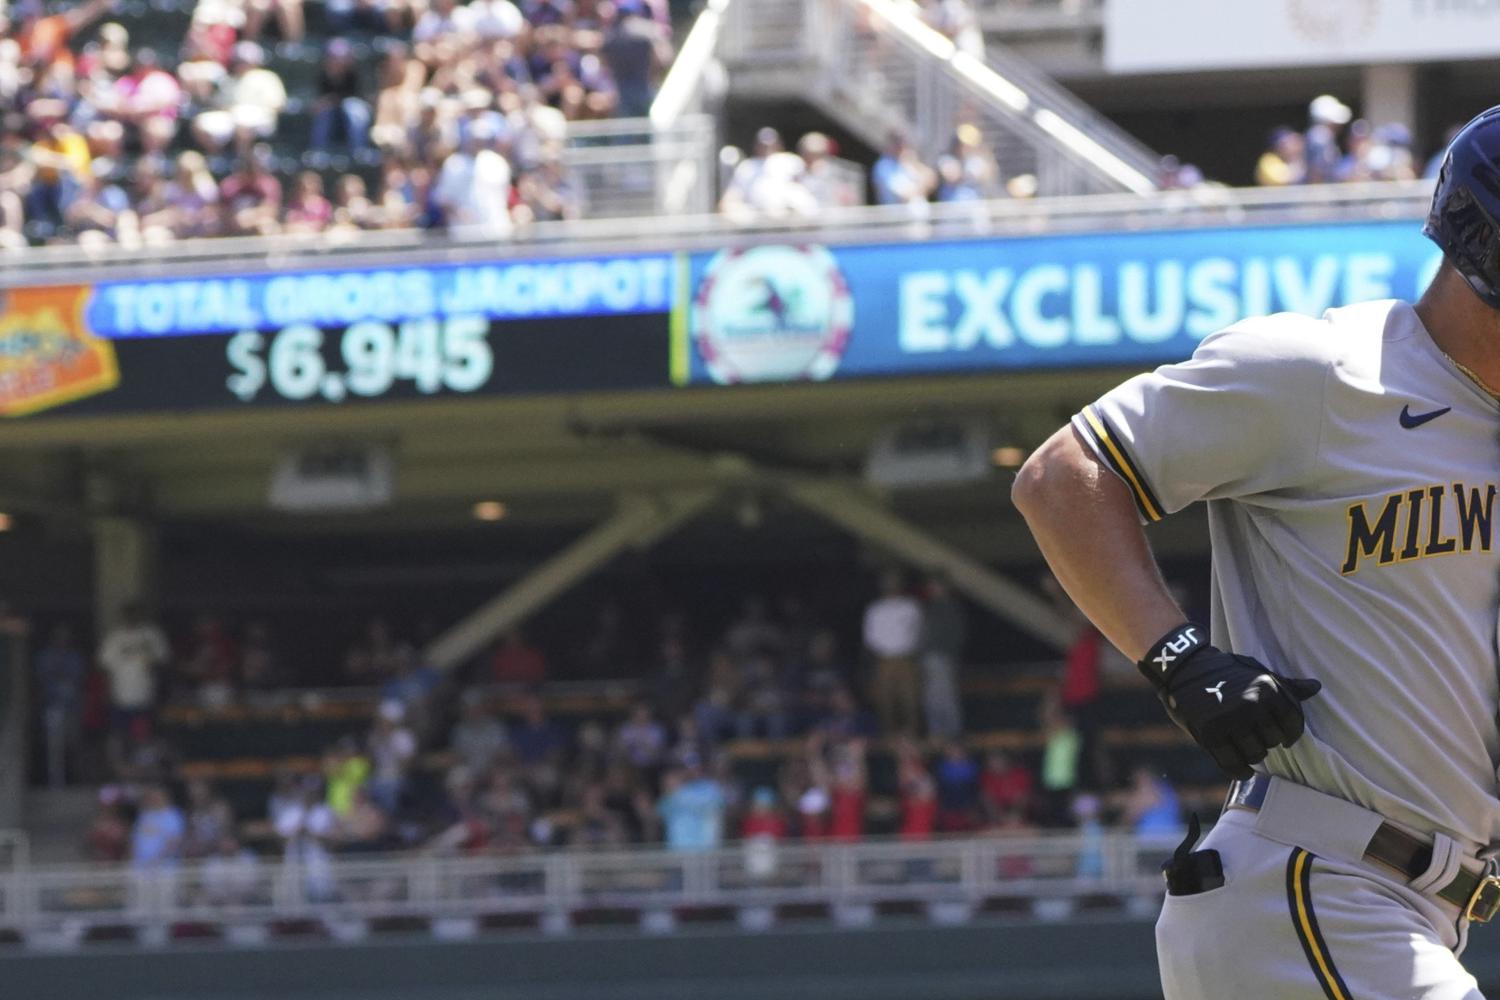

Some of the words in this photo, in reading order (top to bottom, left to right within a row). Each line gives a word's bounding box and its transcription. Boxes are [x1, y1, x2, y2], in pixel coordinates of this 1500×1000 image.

[108, 278, 258, 333] TOTAL
[266, 270, 436, 321] GROSS
[443, 253, 669, 313] JACKPOT
